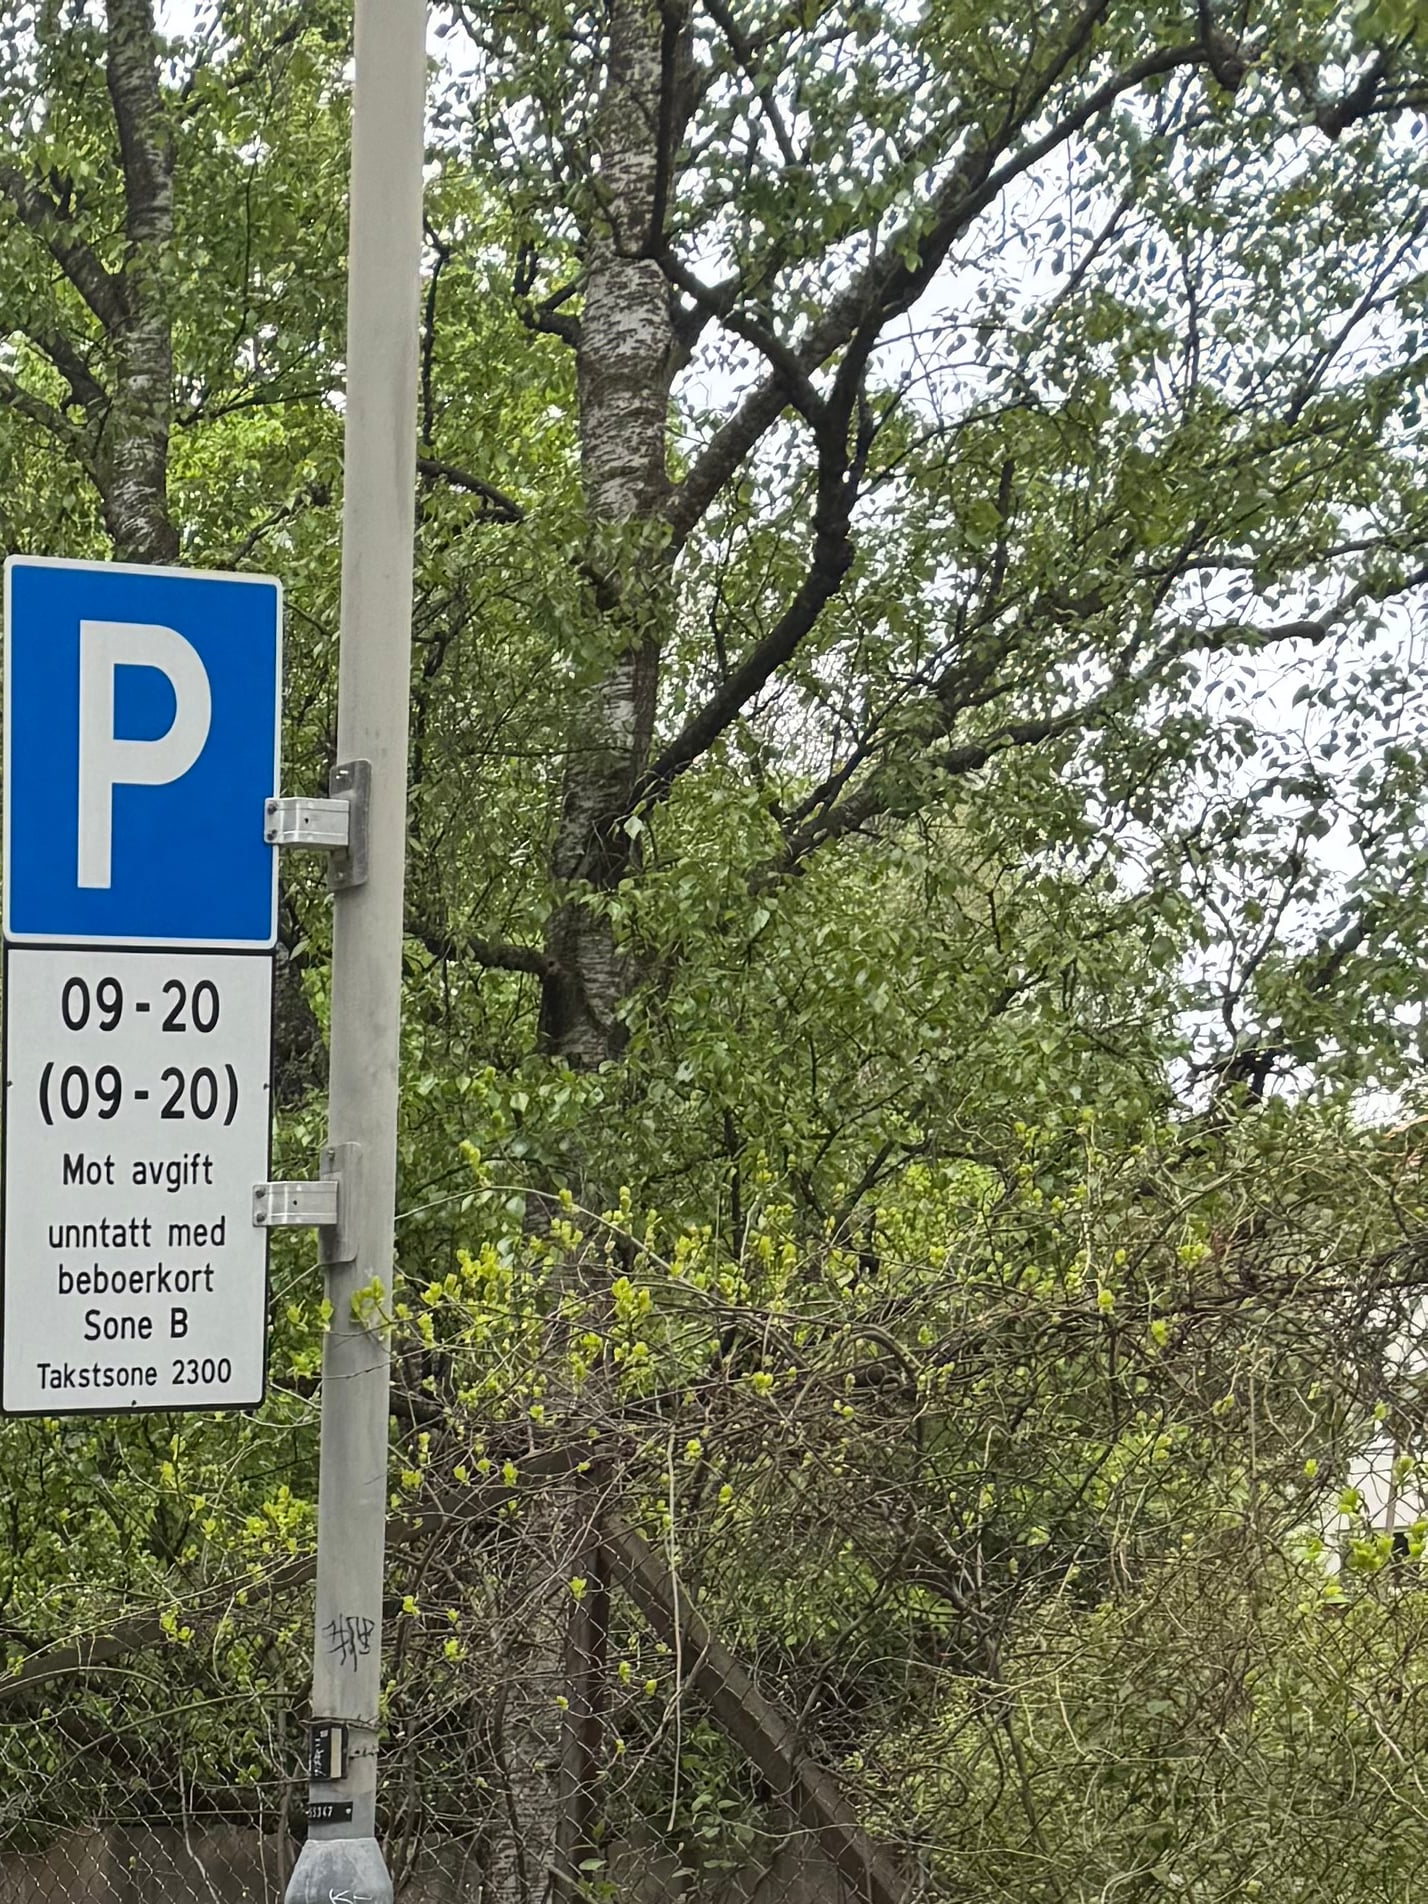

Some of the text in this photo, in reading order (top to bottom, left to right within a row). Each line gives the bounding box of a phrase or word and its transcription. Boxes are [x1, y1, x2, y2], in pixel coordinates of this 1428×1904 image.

[77, 619, 212, 889] P
[60, 976, 221, 1034] 09-20
[38, 1061, 240, 1127] (09-20)
[62, 1152, 214, 1194] Mot avgift
[48, 1215, 226, 1249] unntatt med
[58, 1261, 215, 1295] beboerkort
[83, 1307, 188, 1341] Sone B
[36, 1357, 232, 1390] Takstsone 2300
